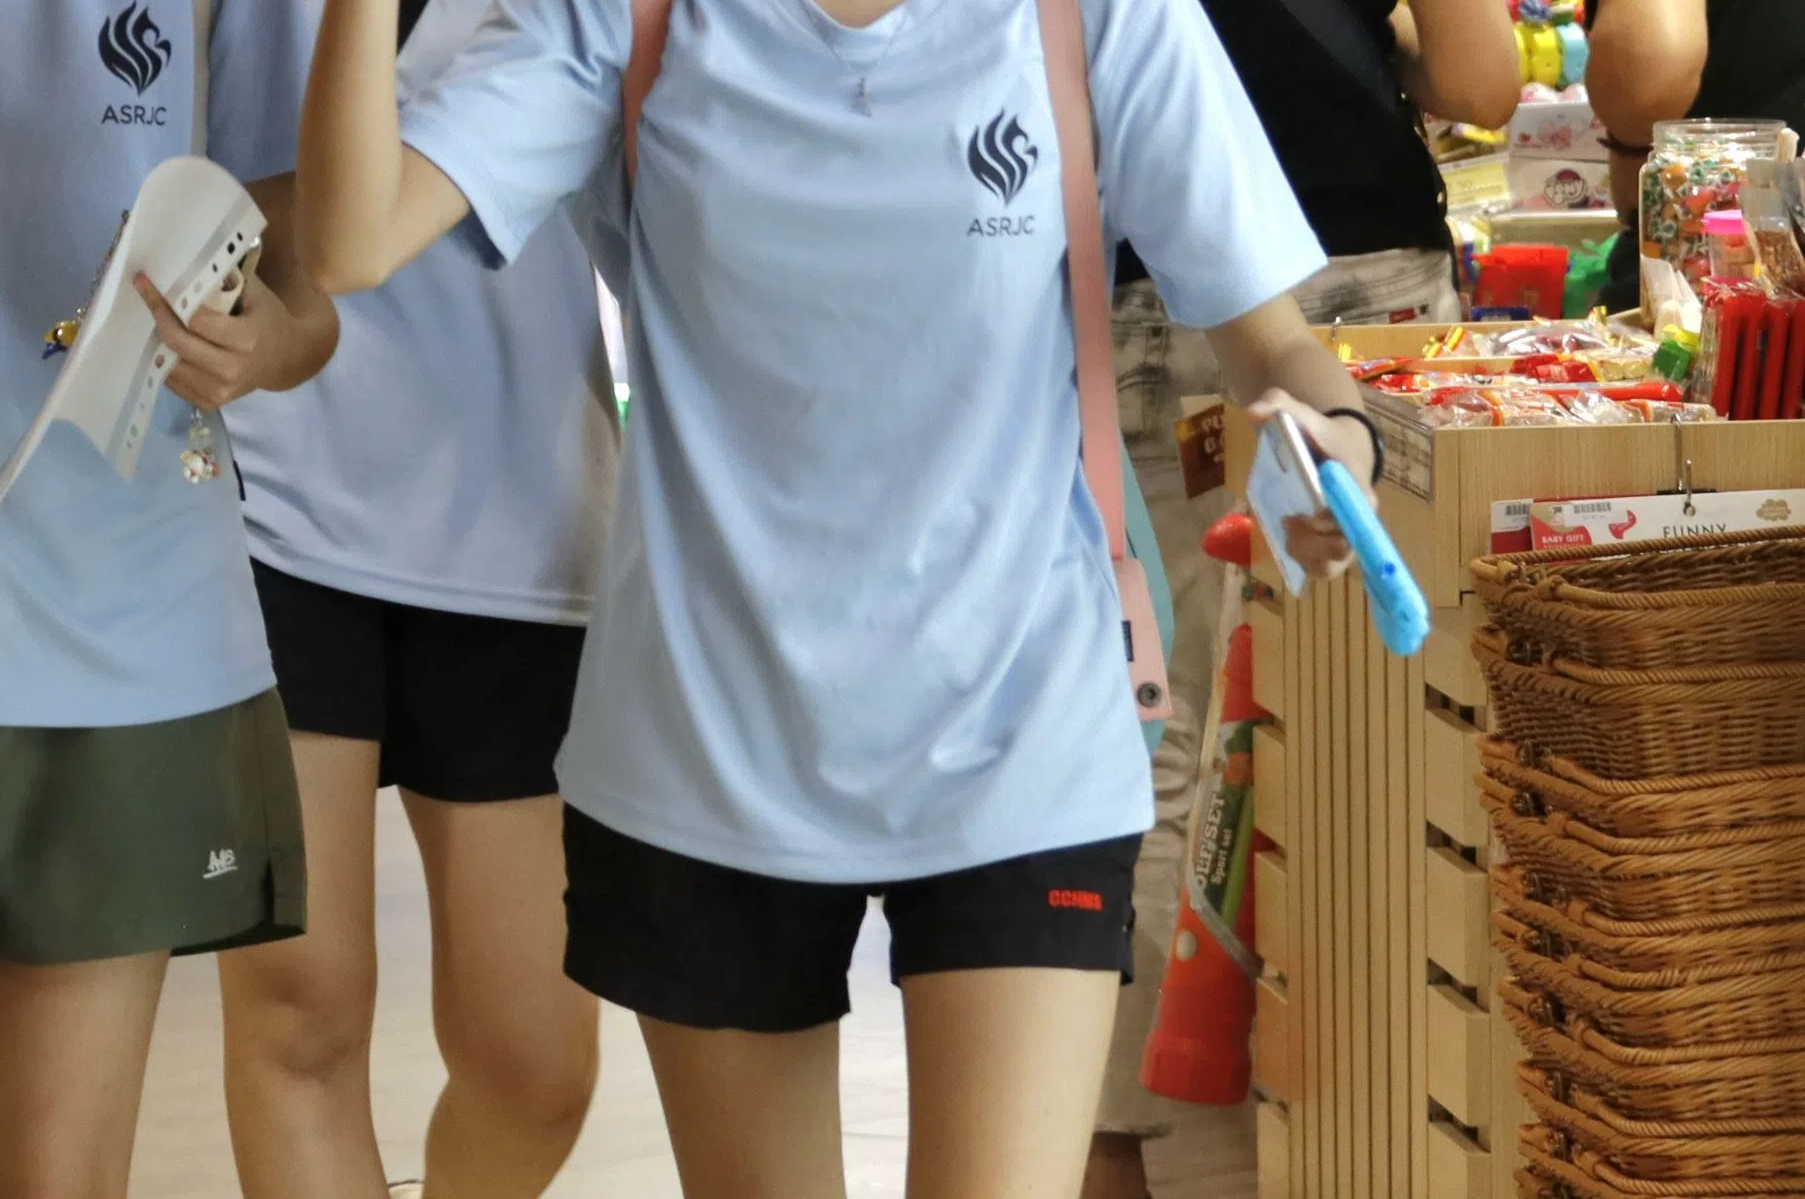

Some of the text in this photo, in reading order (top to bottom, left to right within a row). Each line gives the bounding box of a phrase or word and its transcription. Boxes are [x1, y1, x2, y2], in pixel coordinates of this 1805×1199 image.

[101, 104, 167, 126] ASRJC
[966, 216, 1035, 237] ASRJC
[1541, 534, 1584, 544] BABY GIFT
